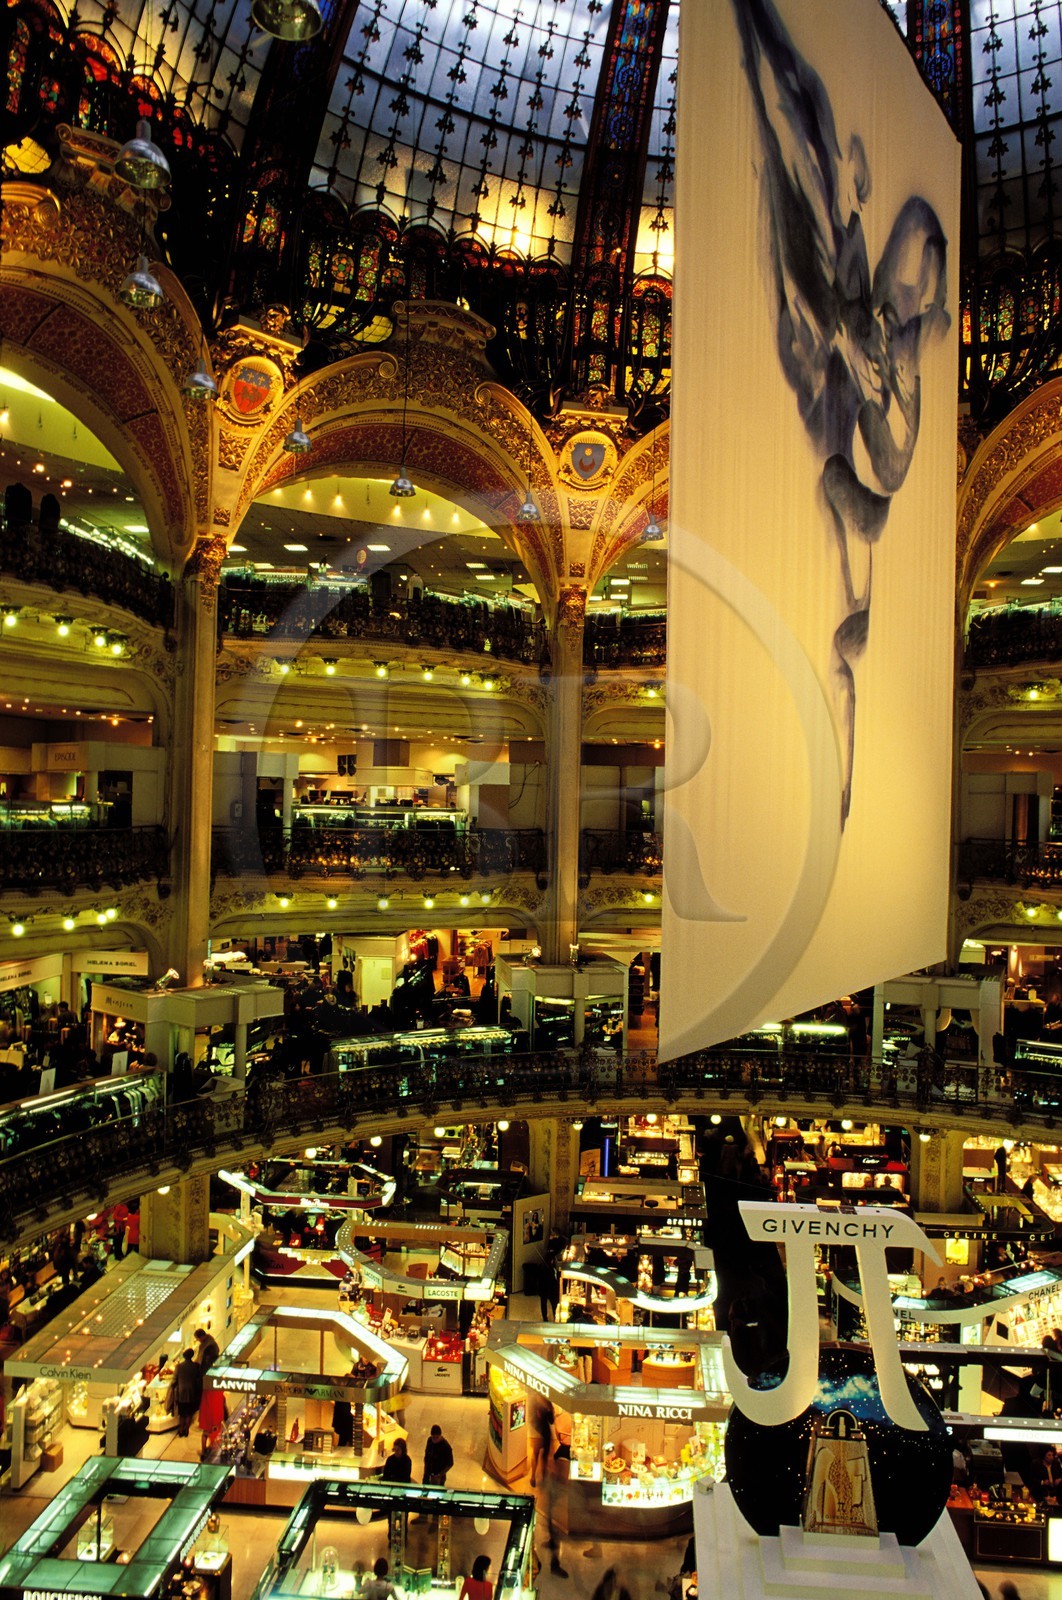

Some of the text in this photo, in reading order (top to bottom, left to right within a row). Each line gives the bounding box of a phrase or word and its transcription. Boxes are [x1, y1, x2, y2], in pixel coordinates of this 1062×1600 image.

[54, 751, 76, 762] EPISODE
[666, 1218, 703, 1227] aramis
[762, 1218, 894, 1239] GIVENCHY
[943, 1230, 998, 1240] CELINE
[427, 1289, 459, 1298] LACOSTE
[1028, 1284, 1061, 1301] CHANEL
[892, 1308, 916, 1321] NEL
[39, 1366, 92, 1380] Calvin Klein
[503, 1360, 550, 1398] NINA RICCI
[212, 1379, 257, 1392] LANVIN
[617, 1403, 693, 1420] NINA RICCI
